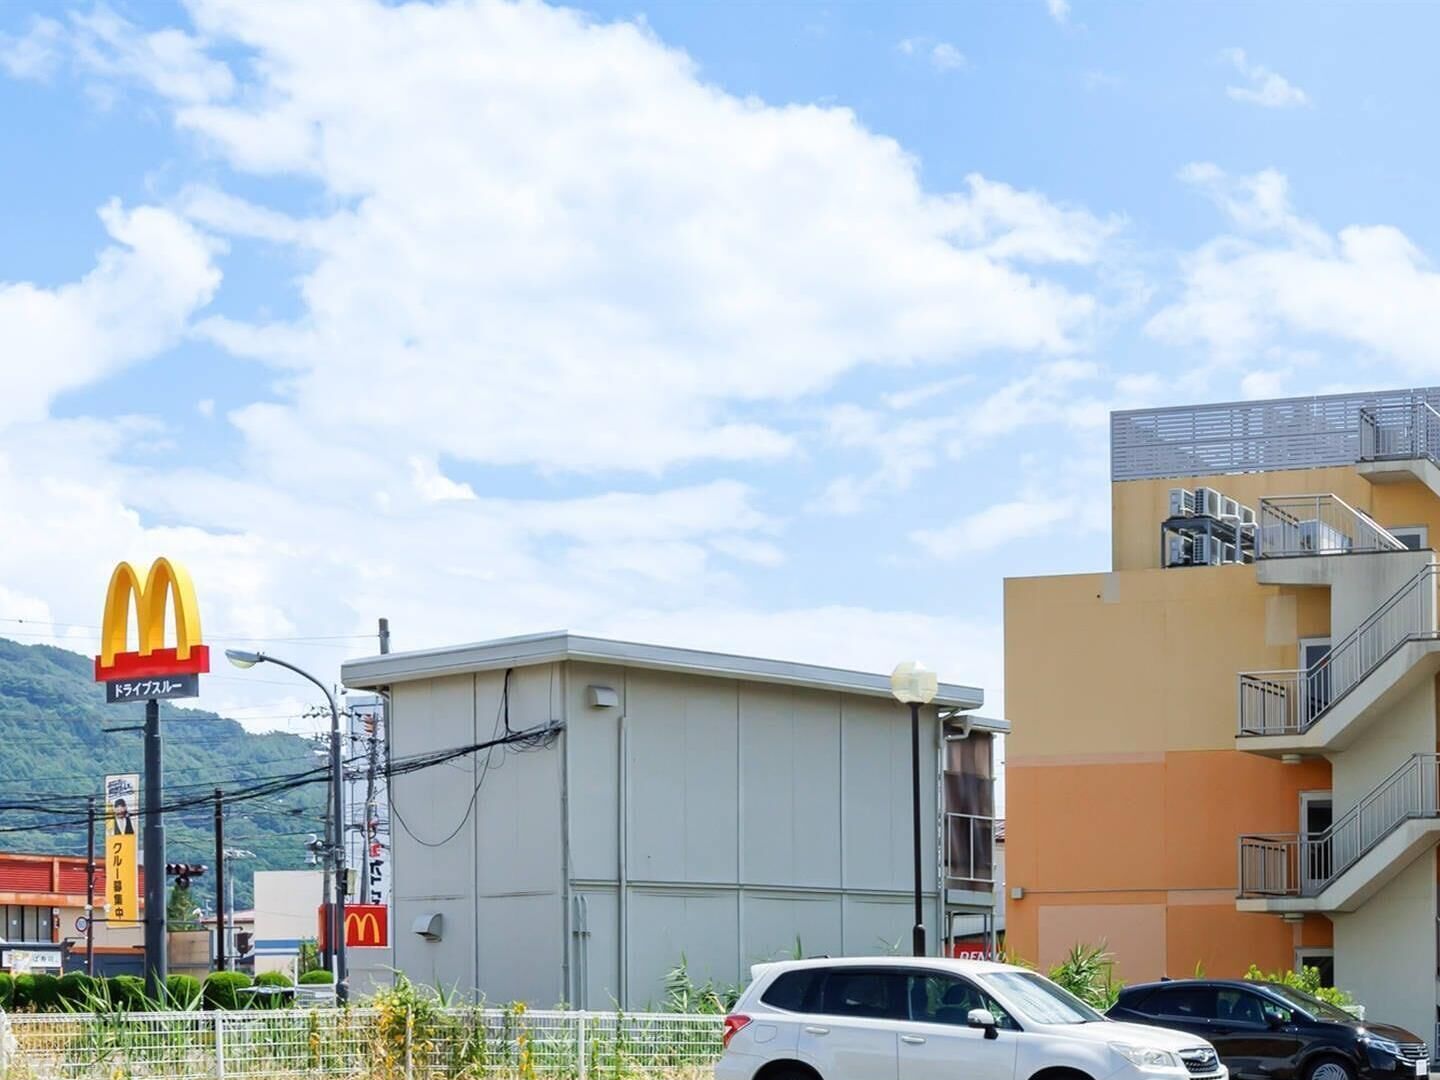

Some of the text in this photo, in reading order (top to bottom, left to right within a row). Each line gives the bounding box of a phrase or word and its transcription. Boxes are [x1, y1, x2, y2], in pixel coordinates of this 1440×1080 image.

[115, 680, 182, 698] ドライブスルー
